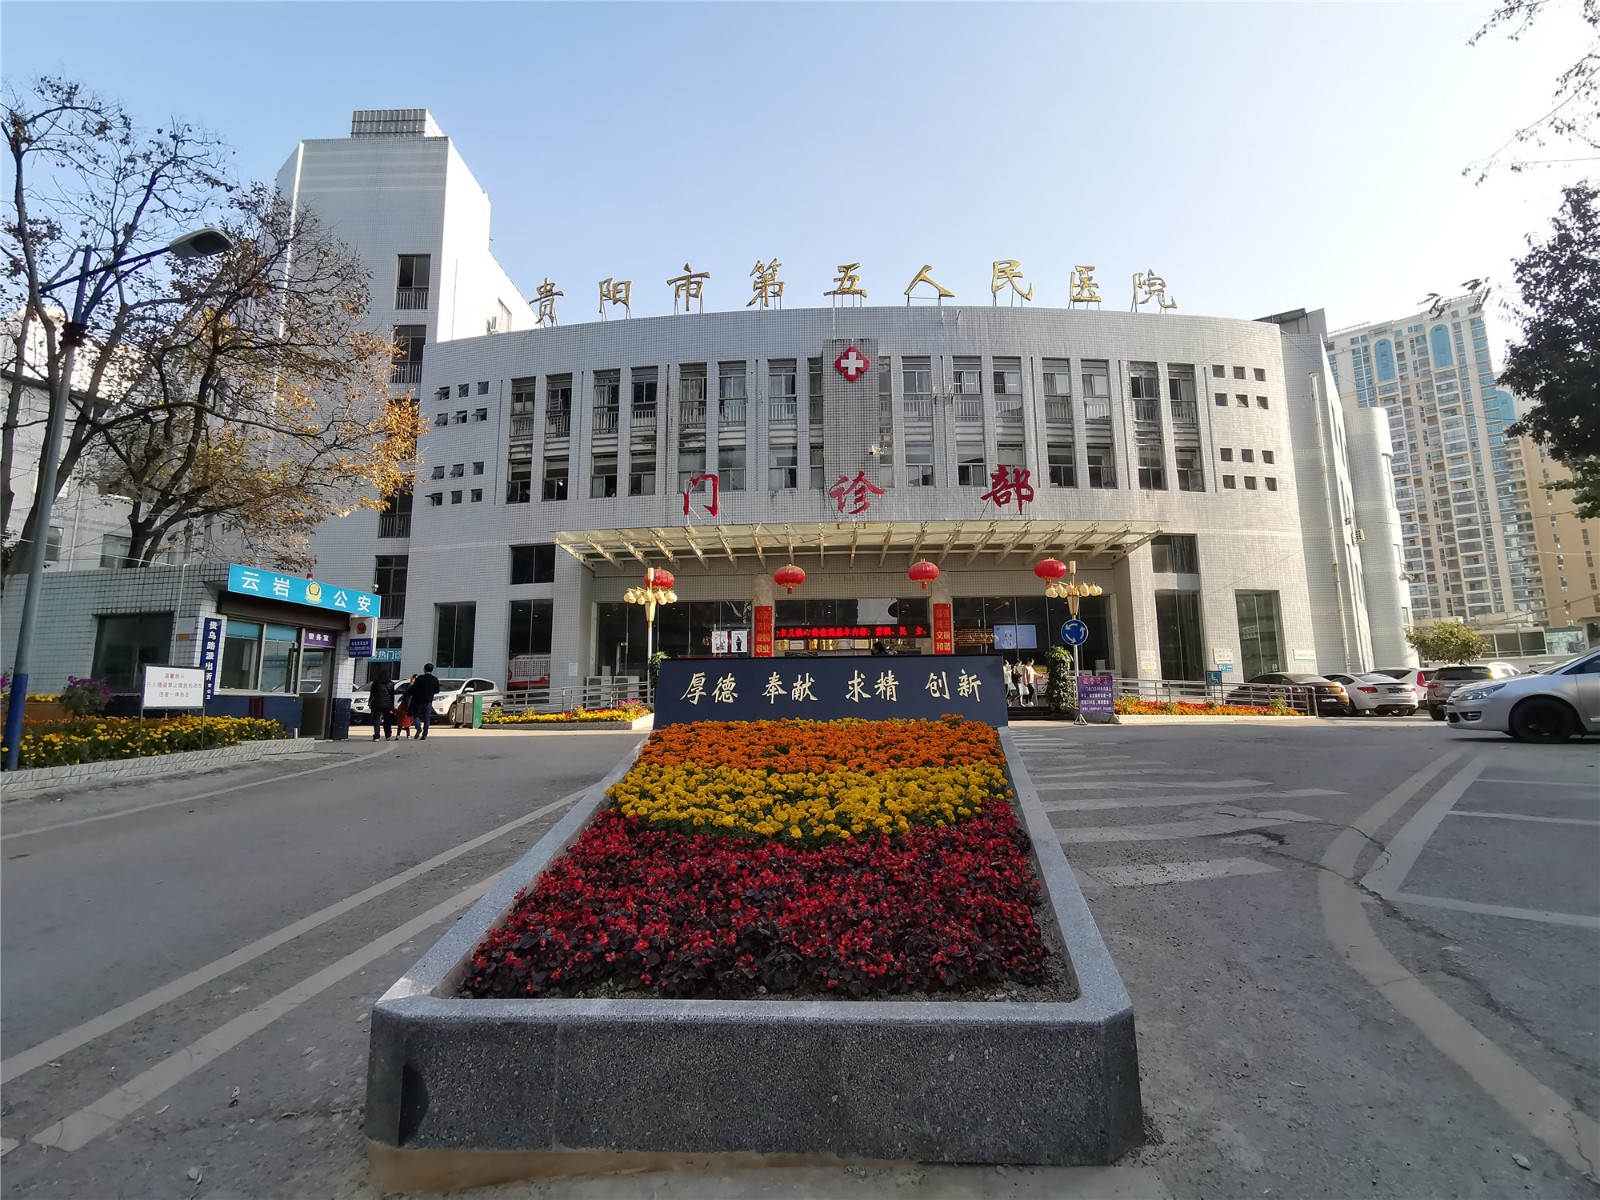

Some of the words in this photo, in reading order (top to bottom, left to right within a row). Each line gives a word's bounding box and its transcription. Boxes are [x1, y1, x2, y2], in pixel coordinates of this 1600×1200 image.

[530, 259, 1178, 326] 贵阳市第五人民医院
[683, 464, 1034, 517] 门诊部
[241, 571, 290, 597] 云岩
[333, 590, 371, 613] 公安
[205, 620, 218, 681] 贵乌路派出所
[308, 632, 329, 642] 警务室
[756, 644, 770, 653] 敬业
[936, 630, 951, 640] 文明
[936, 642, 951, 651] 和谐
[679, 671, 738, 705] 厚德
[762, 671, 818, 705] 奉献
[846, 669, 899, 703] 求精
[925, 668, 982, 703] 创新
